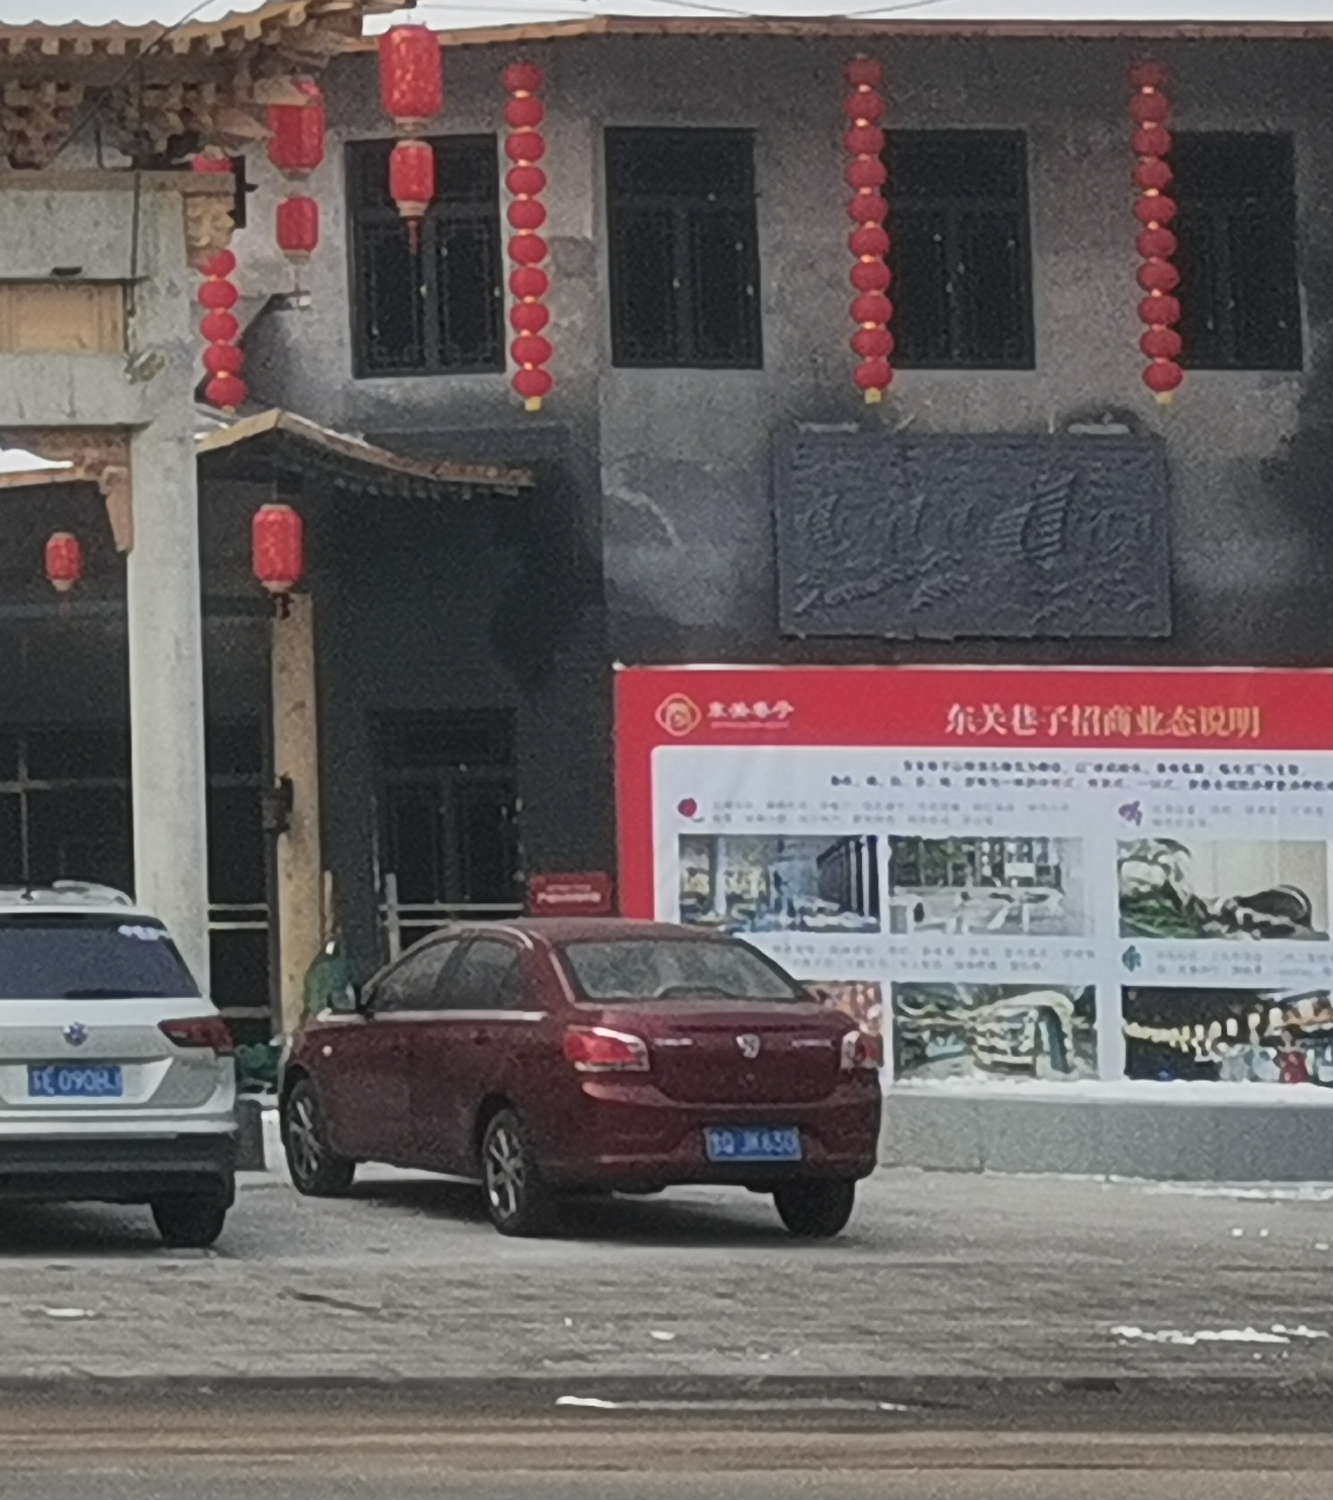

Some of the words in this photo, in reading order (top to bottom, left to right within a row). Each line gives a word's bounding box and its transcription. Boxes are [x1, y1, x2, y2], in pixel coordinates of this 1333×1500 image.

[944, 703, 1260, 737] 东关巷子招商业态说明
